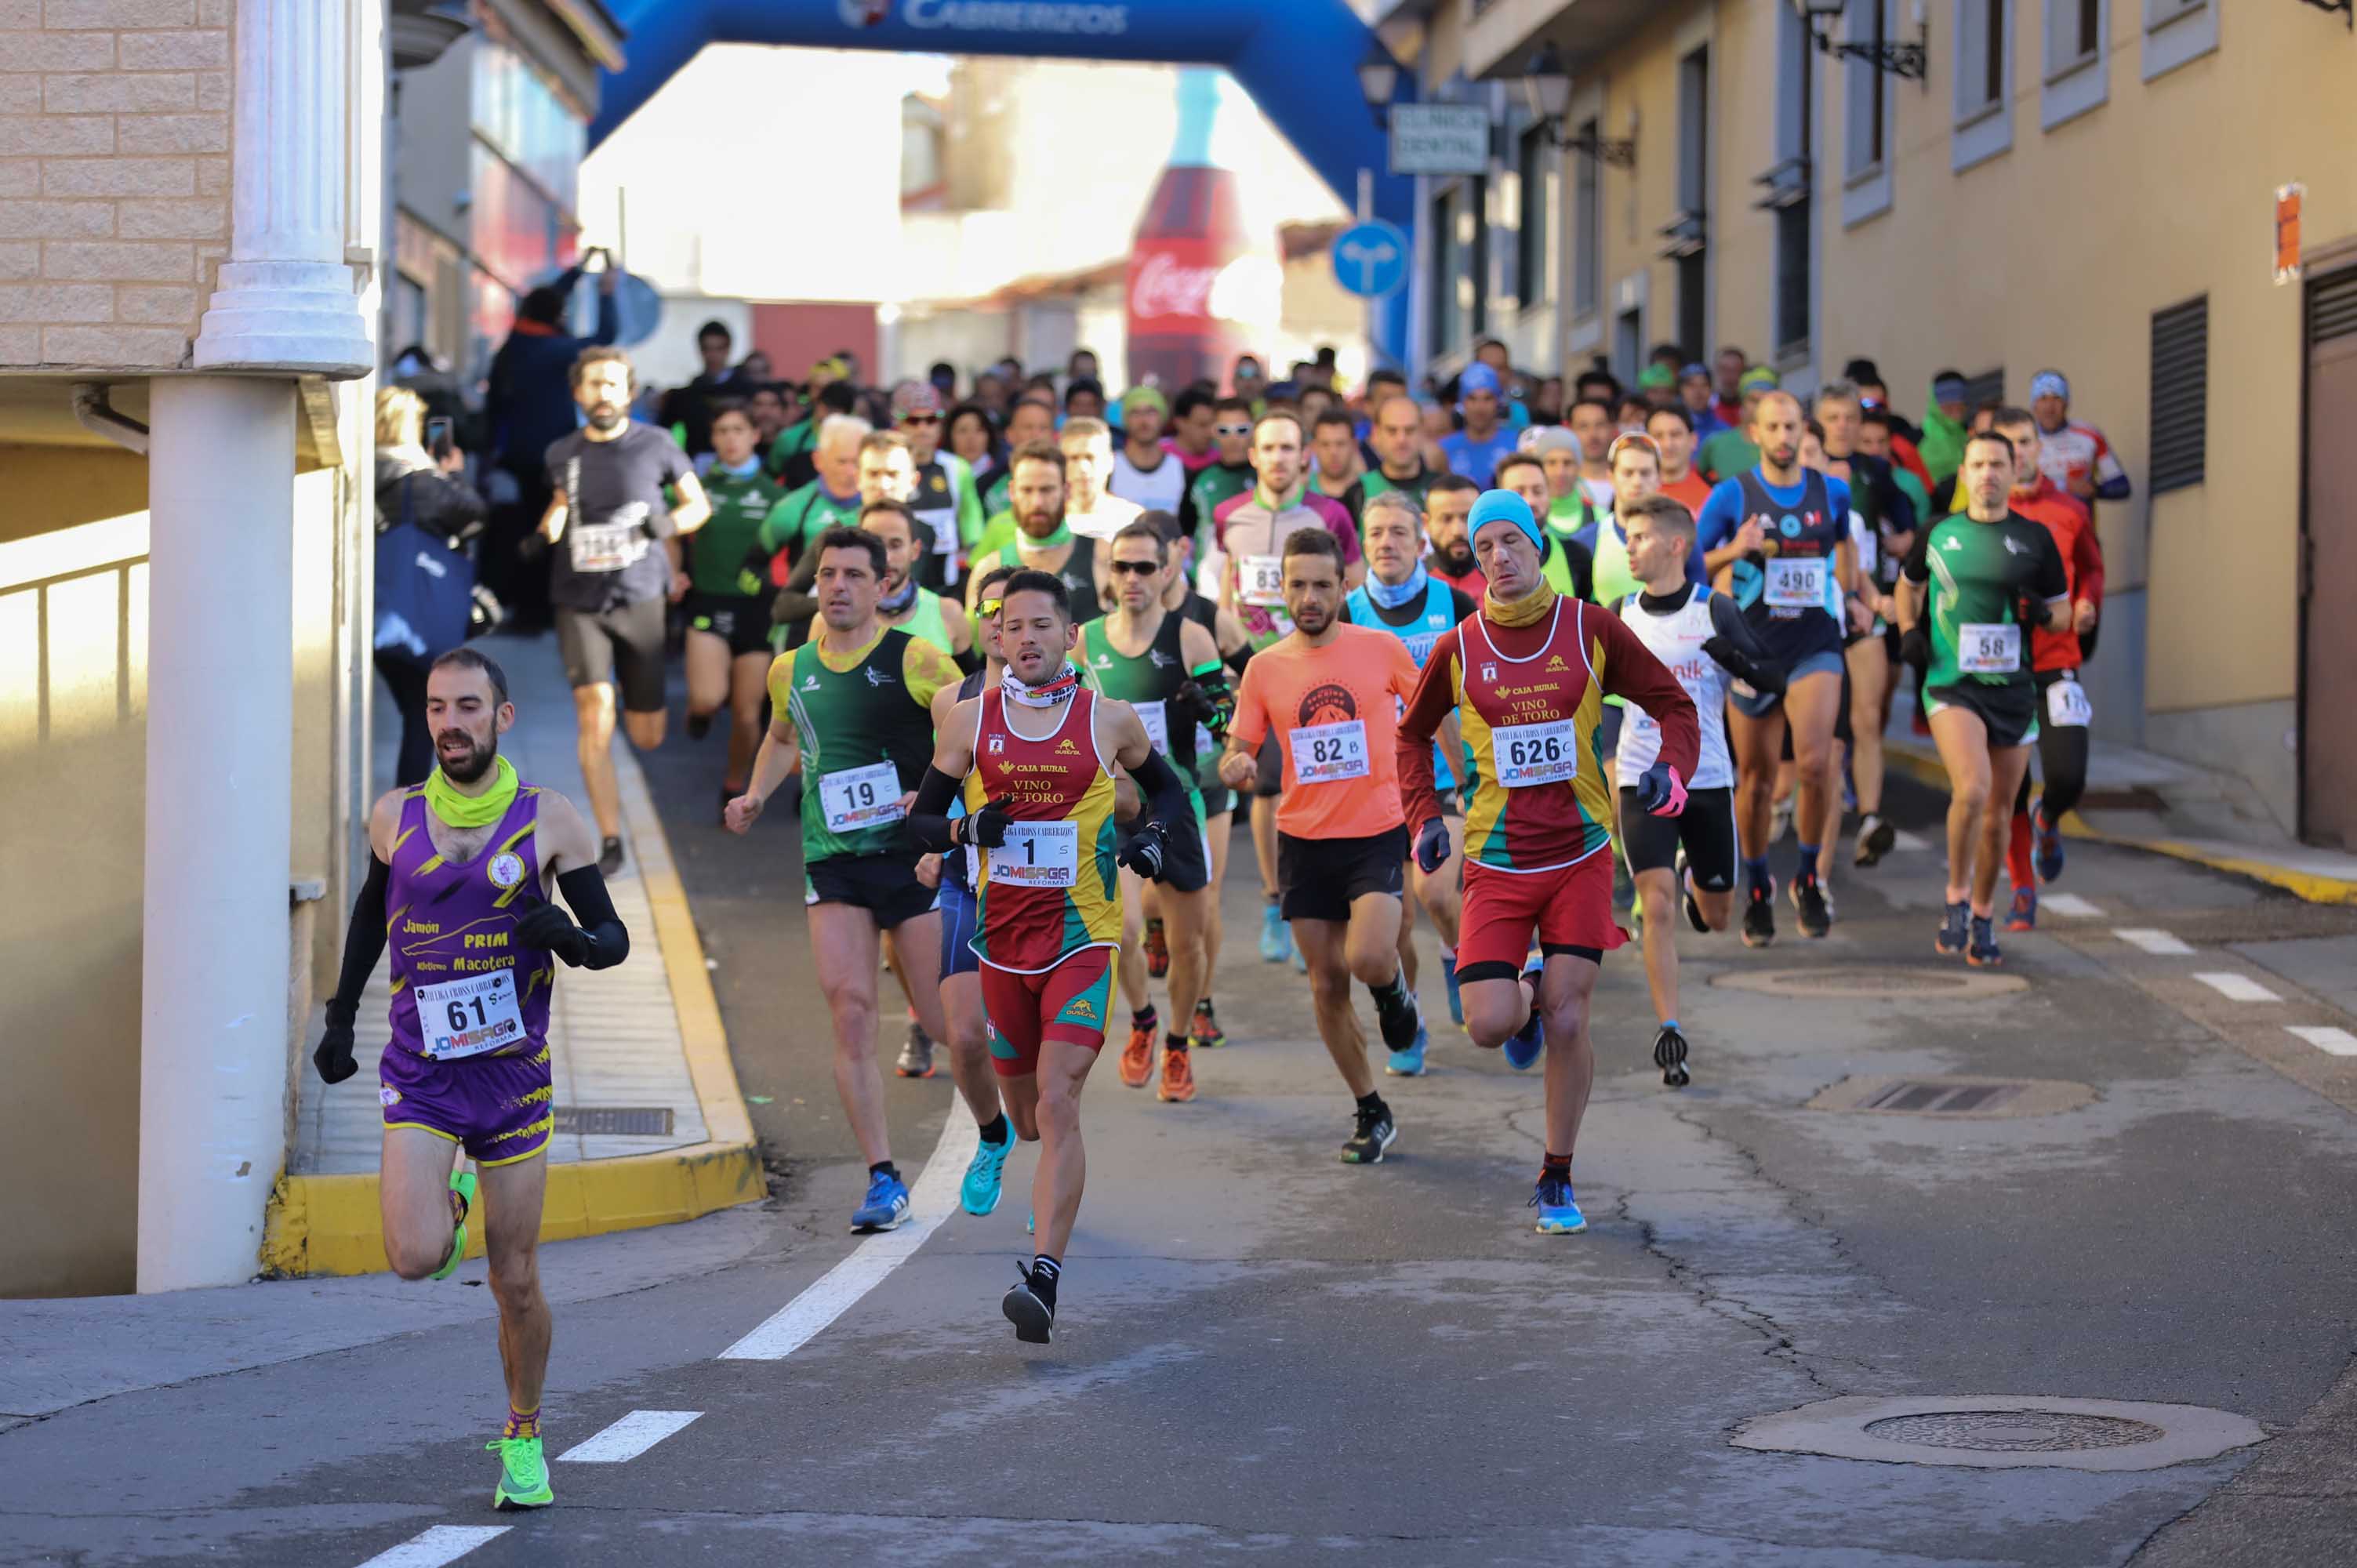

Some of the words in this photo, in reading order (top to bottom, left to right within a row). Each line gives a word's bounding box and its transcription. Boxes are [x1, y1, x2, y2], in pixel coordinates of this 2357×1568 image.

[1778, 570, 1815, 589] 490
[1980, 637, 2005, 657] 58
[1513, 686, 1532, 695] CAJA
[1534, 682, 1560, 691] RURAL
[1512, 699, 1546, 712] VINO
[1502, 714, 1520, 725] DE
[1521, 709, 1560, 721] TORO
[1313, 738, 1343, 762] 82
[1510, 737, 1560, 766] 626
[1040, 764, 1069, 774] RURAL
[1502, 760, 1572, 780] JOMISAGA
[1013, 779, 1051, 790] VINO
[843, 782, 875, 809] 19
[1023, 792, 1064, 803] TORO
[1004, 826, 1017, 837] LIGA
[1018, 827, 1037, 837] CROSS
[1022, 838, 1034, 865] 1
[993, 864, 1070, 880] JOMISAGA
[403, 919, 440, 934] Jamón
[464, 931, 509, 949] PRIM
[453, 954, 515, 971] Macotera
[447, 995, 487, 1032] 61
[474, 1033, 517, 1051] REFORMAS
